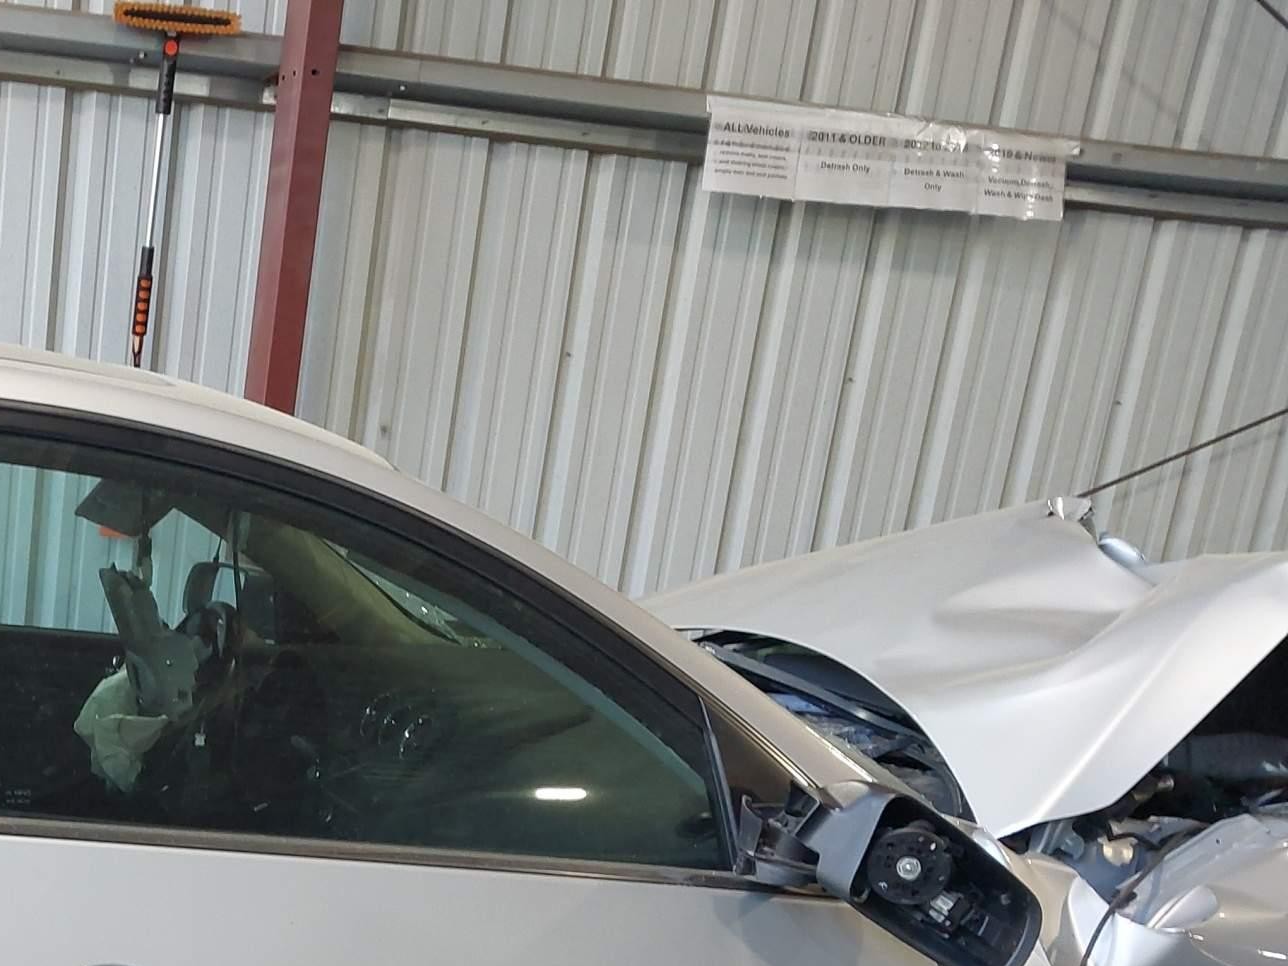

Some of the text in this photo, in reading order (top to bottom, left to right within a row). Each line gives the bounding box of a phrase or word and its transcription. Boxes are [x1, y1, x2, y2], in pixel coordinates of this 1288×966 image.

[723, 121, 790, 138] ALL Vehicles
[809, 130, 886, 147] 2011 & OLDER
[820, 161, 870, 174] Detrash Only
[904, 167, 934, 177] Detrash
[943, 169, 965, 179] Wash
[923, 182, 942, 192] Only
[984, 189, 1006, 199] Wash
